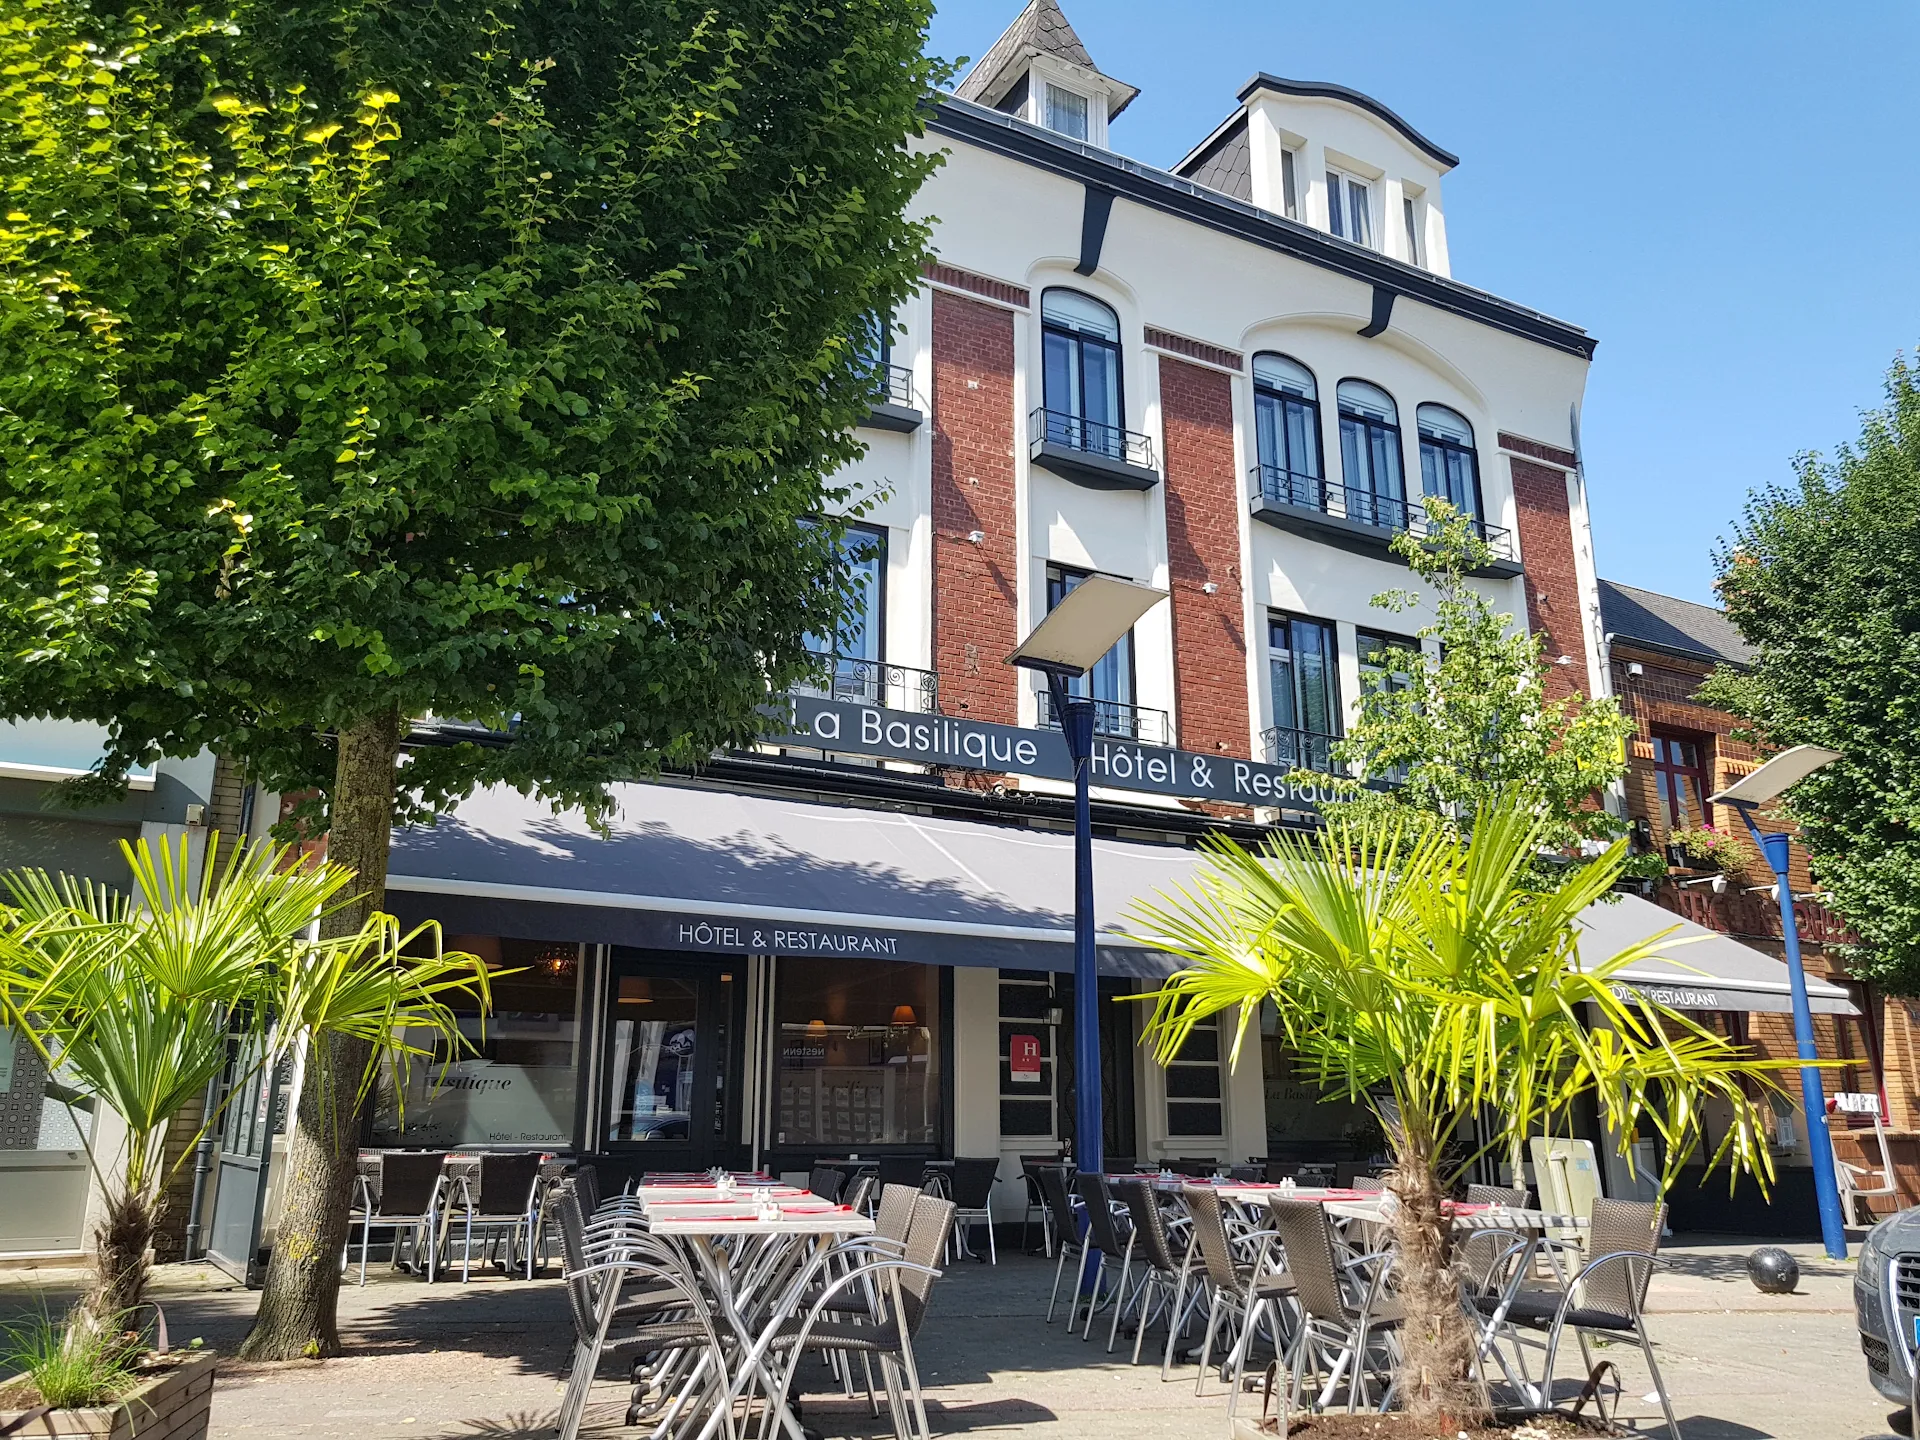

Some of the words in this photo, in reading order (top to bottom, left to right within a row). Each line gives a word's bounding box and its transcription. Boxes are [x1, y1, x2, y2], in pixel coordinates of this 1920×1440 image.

[861, 708, 1038, 768] Basilique
[1091, 741, 1176, 785] Hôtel
[1190, 755, 1215, 789] &
[679, 921, 744, 947] HÔTEL
[752, 930, 767, 948] &
[774, 930, 897, 955] RESTAURANT
[1650, 989, 1718, 1006] RESTAURANT
[1024, 1042, 1037, 1056] H
[489, 1132, 513, 1141] Hôtel
[520, 1133, 566, 1141] Restaurant
